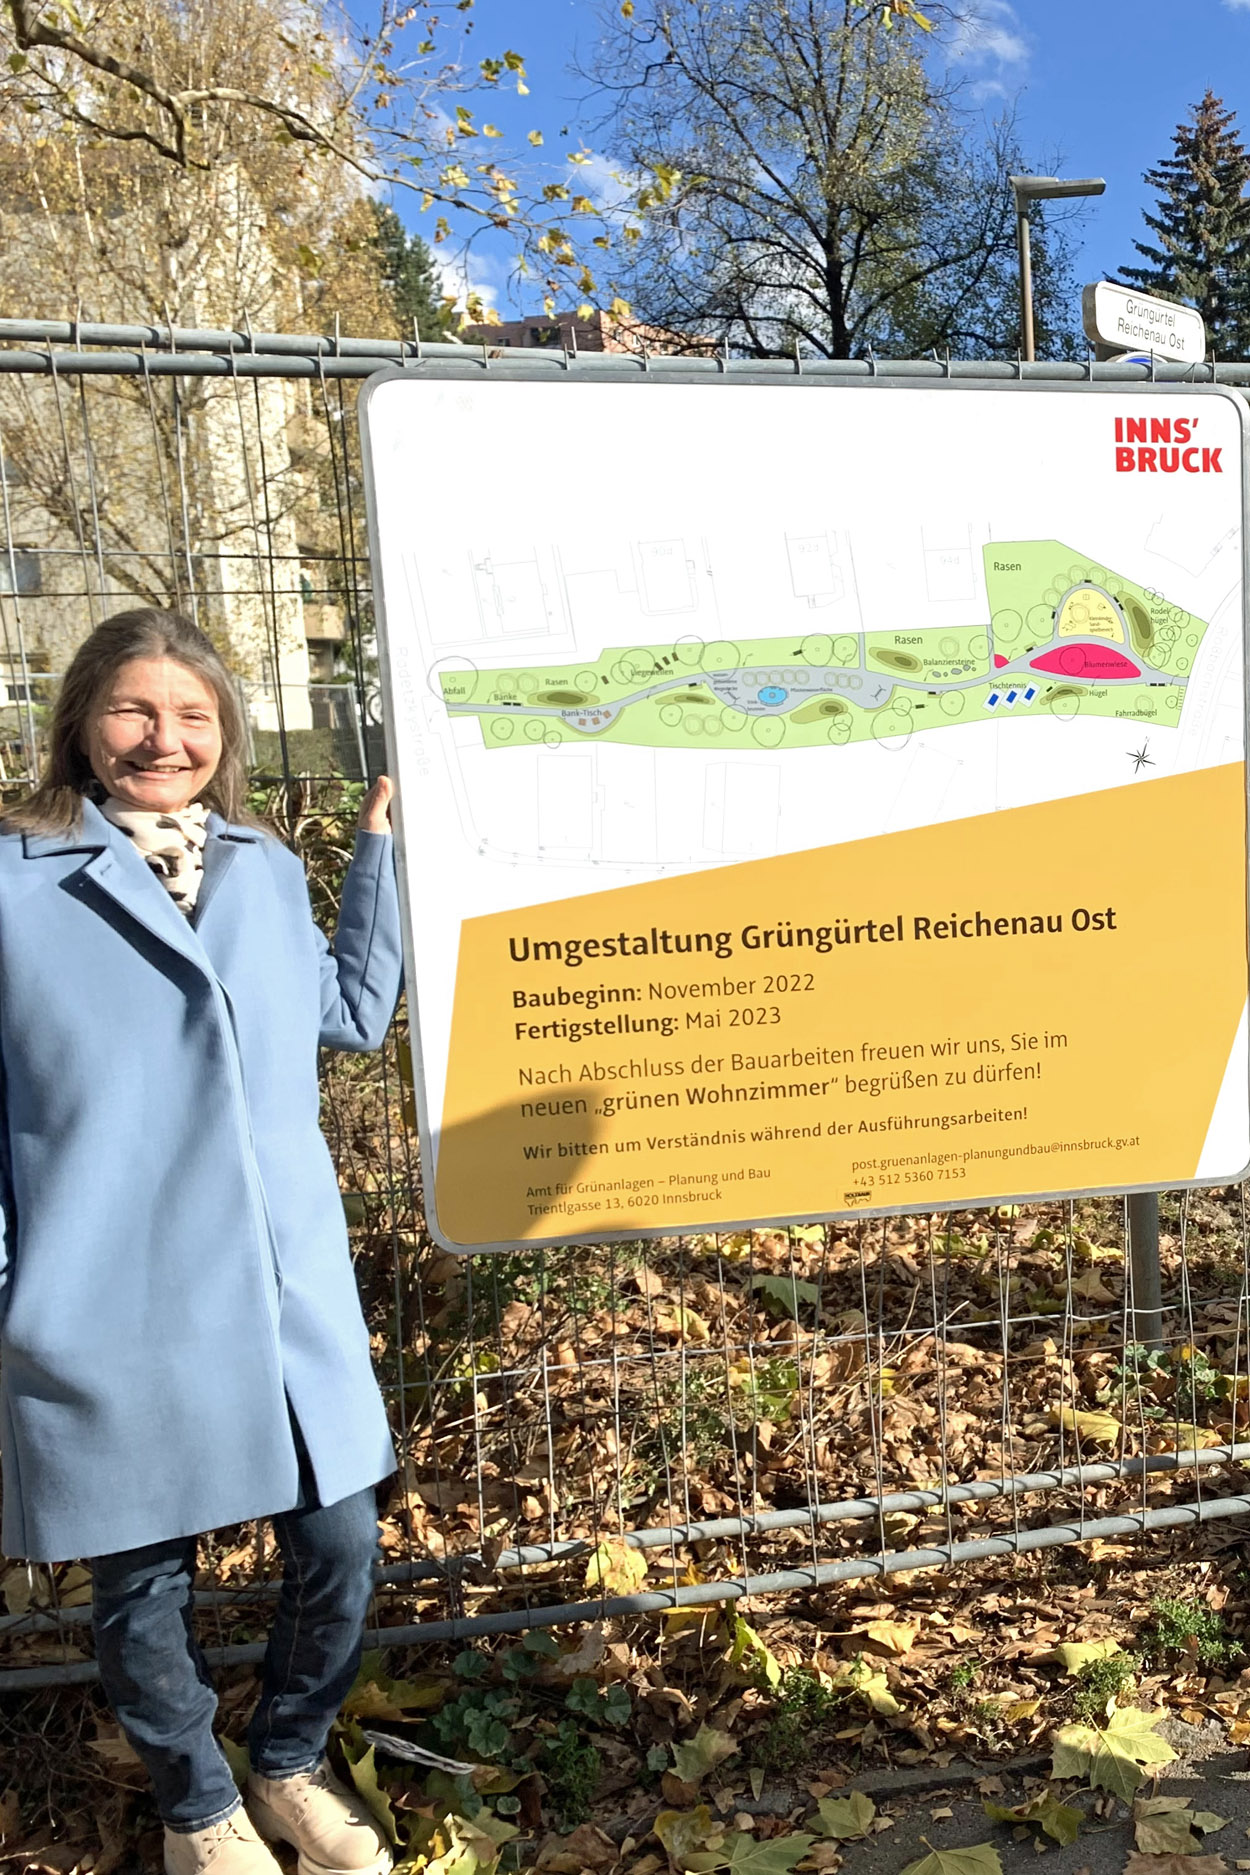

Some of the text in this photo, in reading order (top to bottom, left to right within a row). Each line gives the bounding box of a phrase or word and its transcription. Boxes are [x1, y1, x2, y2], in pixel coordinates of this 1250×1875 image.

[1126, 299, 1176, 327] Grüngürtel
[1118, 317, 1185, 350] Reichenau Ost
[1115, 447, 1223, 473] BRUCK
[993, 561, 1022, 571] Rasen
[1150, 616, 1169, 625] hügel
[894, 635, 923, 645] Rasen
[443, 687, 466, 696] Abfall
[545, 678, 569, 687] Rasen
[989, 682, 1027, 690] Tischtennis
[1089, 690, 1108, 698] Hügel
[494, 693, 518, 702] Bänke
[561, 708, 603, 718] Bank-Tisch
[1115, 709, 1158, 718] Fahrradbügel
[509, 907, 1117, 967] Umgestaltung Grüngürtel Reichenau Ost
[512, 973, 815, 1010] Baubeginn: November 2022
[515, 1006, 781, 1043] Fertigstellung: Mai 2023
[519, 1031, 1067, 1086] Nach Abschluss der Bauarbeiten freuen wir uns, Sie im
[521, 1099, 587, 1118] neuen
[845, 1069, 938, 1097] begrüßen
[945, 1071, 966, 1086] zu
[973, 1062, 1041, 1084] dürfen!
[523, 1107, 1027, 1160] Wir bitten um Verständnis während der Ausführungsarbeiten!
[851, 1135, 1141, 1174] post.gruenanlagen-planungundbau@innsbruck.gv.at
[526, 1186, 552, 1198] Amt
[555, 1183, 572, 1195] für
[576, 1179, 654, 1193] Grünanlagen
[669, 1174, 718, 1185] Planung
[722, 1169, 744, 1181] und
[748, 1169, 770, 1179] Bau
[852, 1167, 967, 1188] +43 512 5360 7153
[527, 1189, 722, 1215] Trientlgasse 13, 6020 Innsbruck
